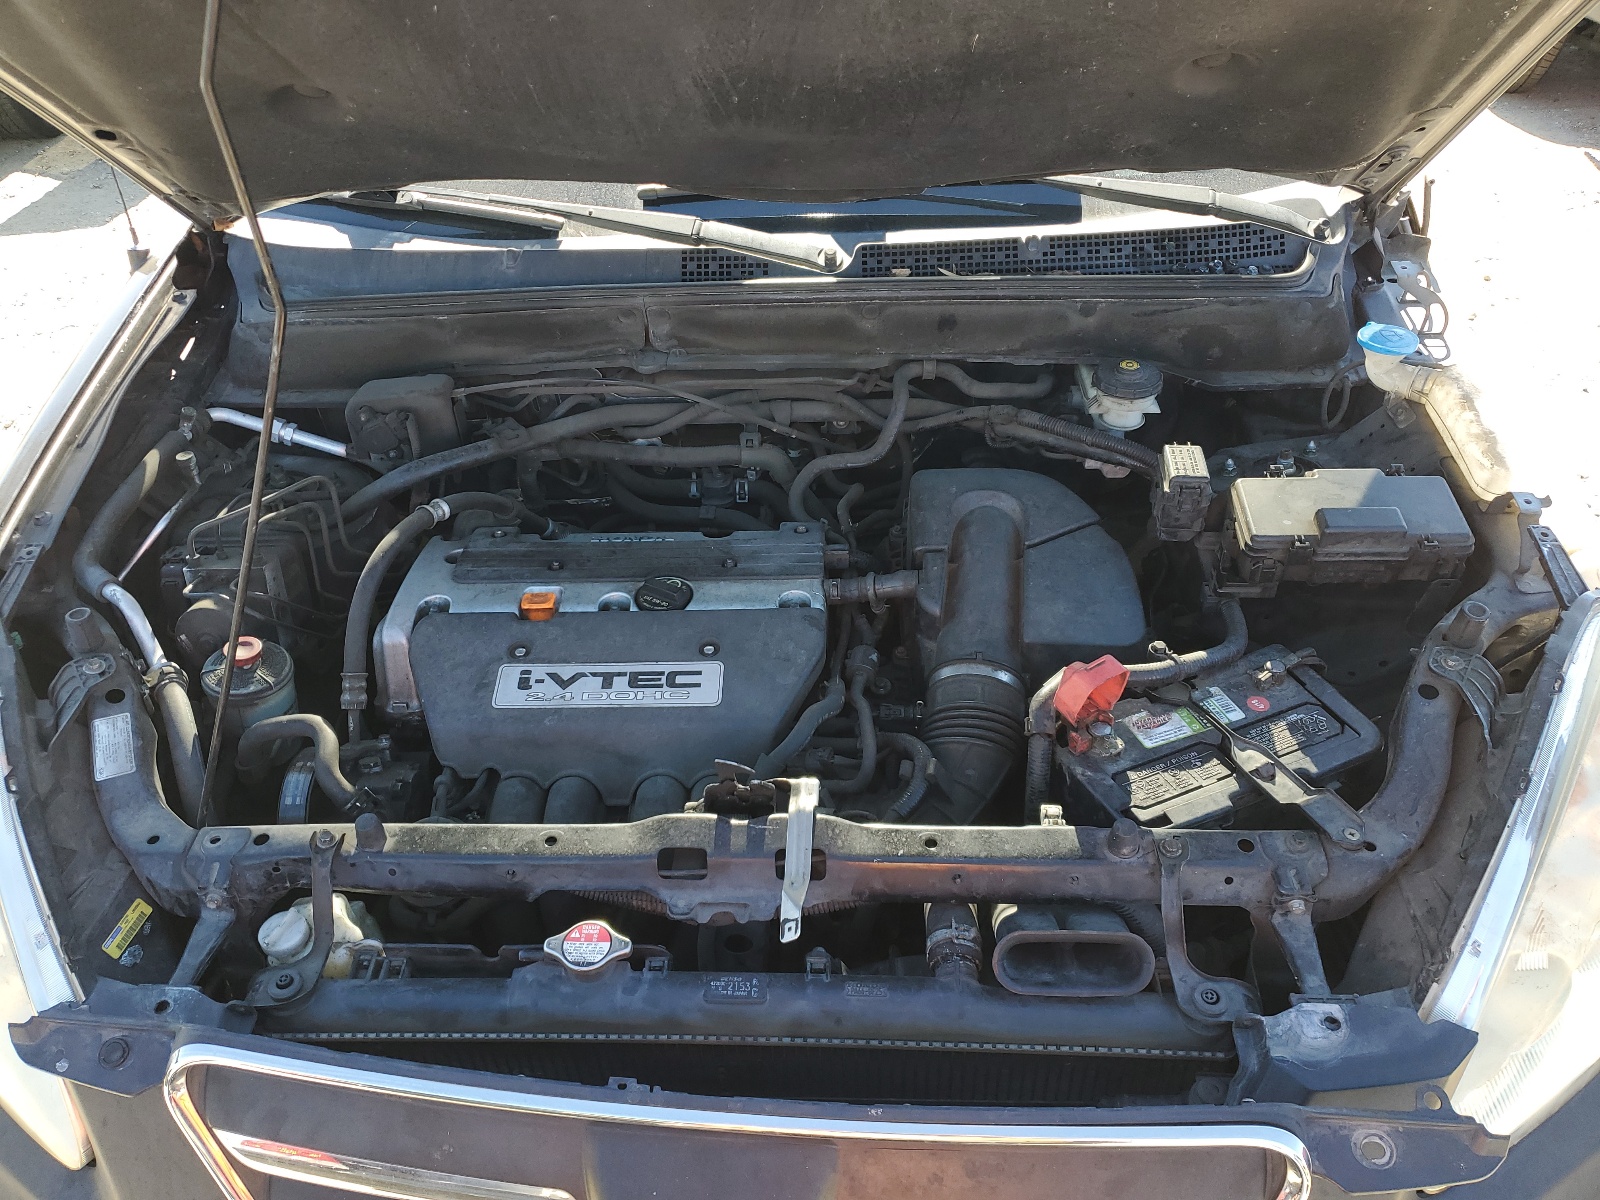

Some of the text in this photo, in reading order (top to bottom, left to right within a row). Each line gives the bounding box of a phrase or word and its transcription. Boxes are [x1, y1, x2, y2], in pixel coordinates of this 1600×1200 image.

[517, 669, 703, 690] i-VTEC
[525, 690, 691, 702] 2.4 DOHC
[1137, 762, 1166, 777] DANGER
[1171, 751, 1198, 764] POISON
